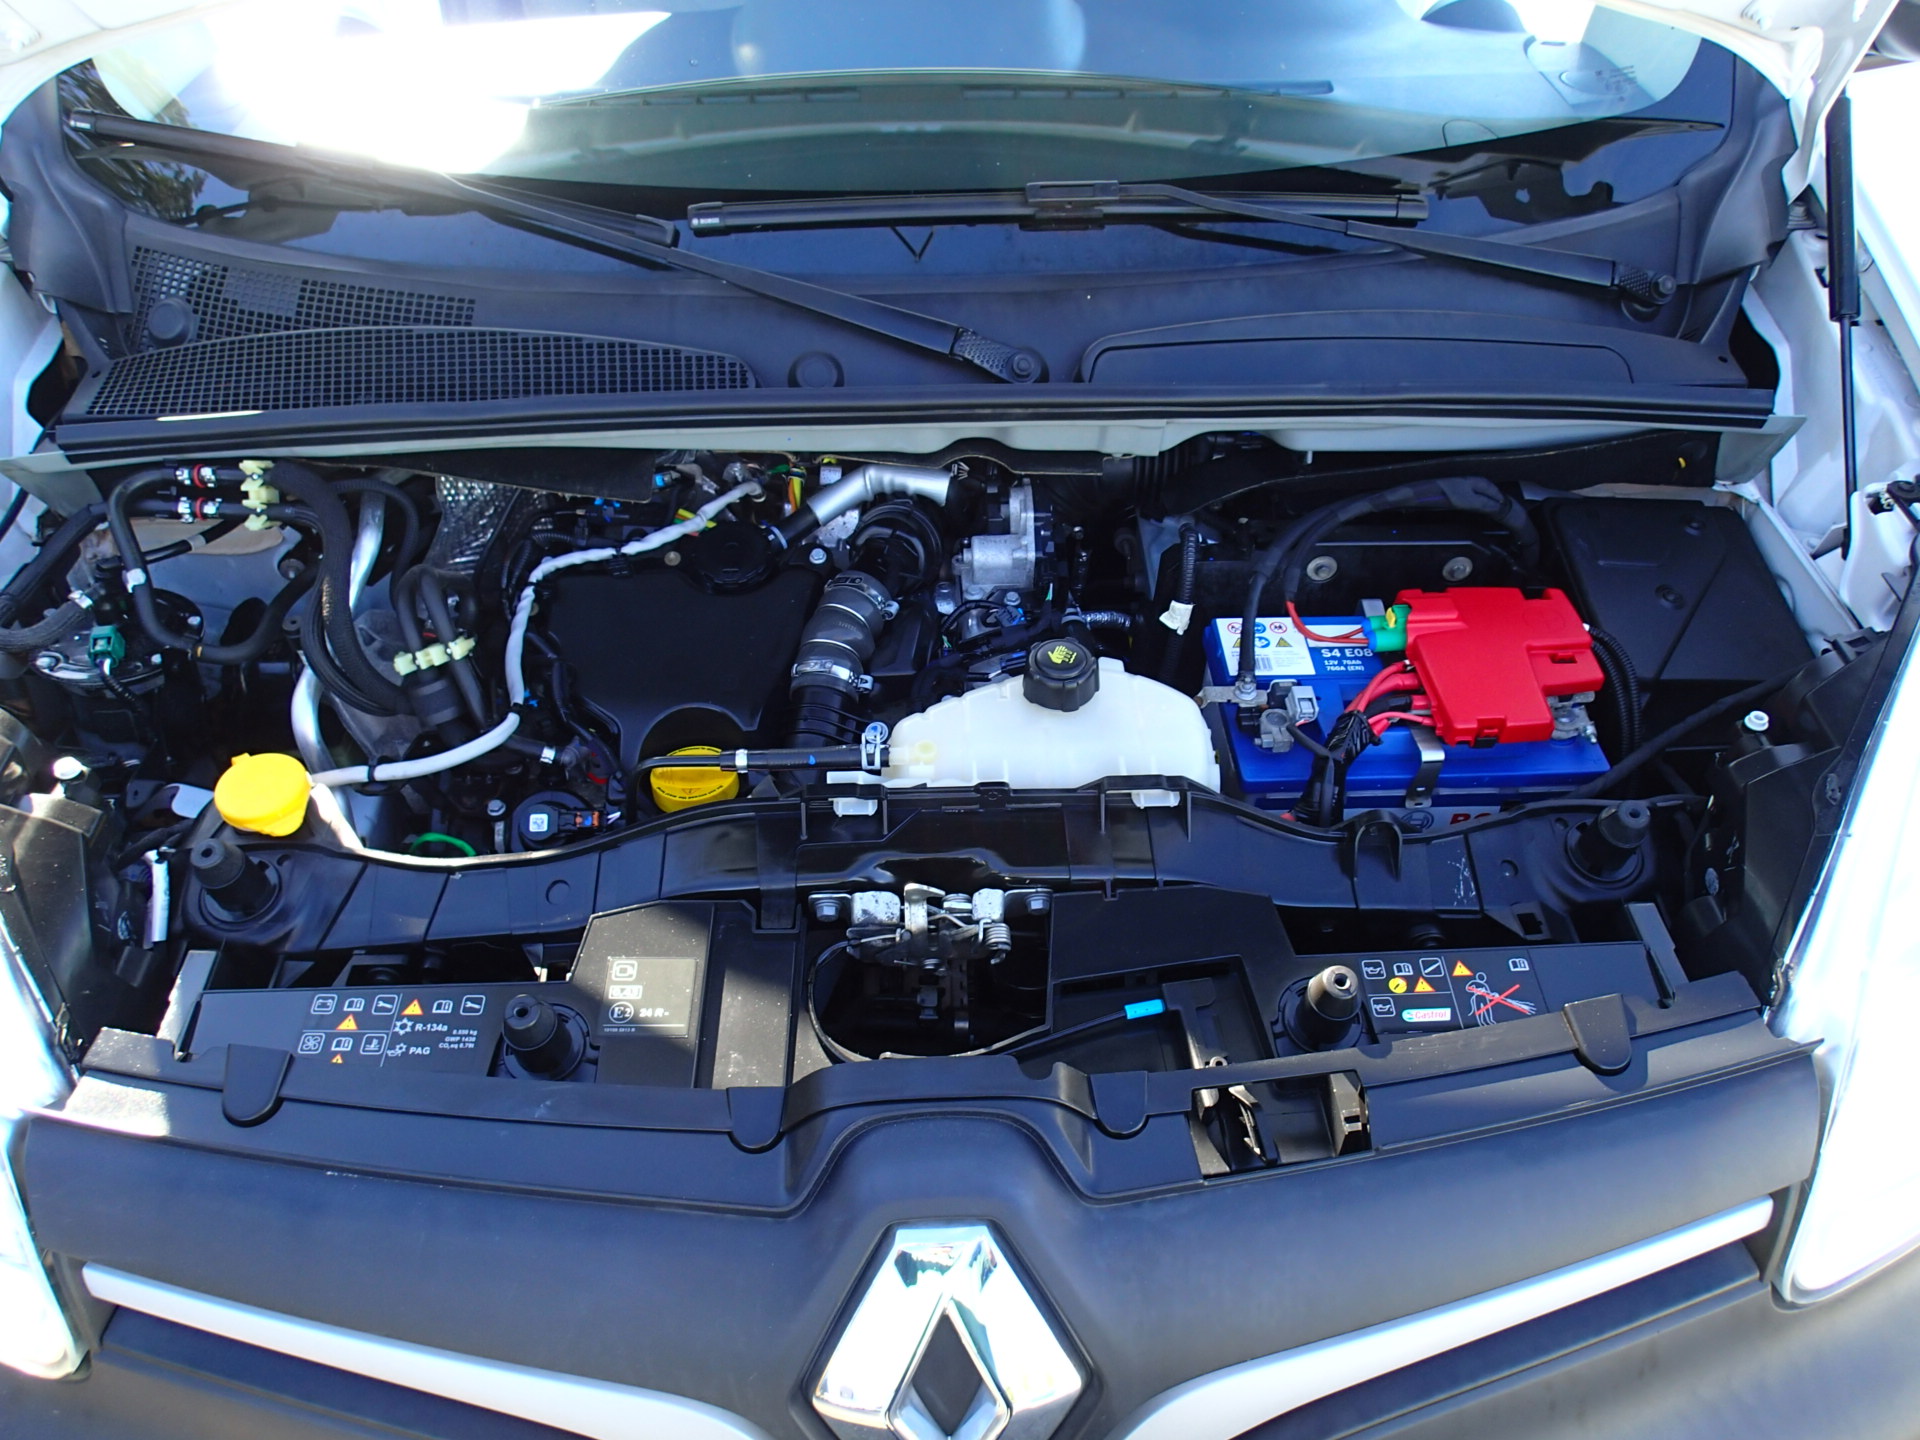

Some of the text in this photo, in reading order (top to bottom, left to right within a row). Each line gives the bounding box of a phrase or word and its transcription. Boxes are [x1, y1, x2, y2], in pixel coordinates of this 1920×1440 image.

[1321, 648, 1373, 658] S4 E08
[613, 1006, 631, 1018] E2
[1415, 1010, 1447, 1019] Castrol
[414, 1023, 448, 1032] R-134a
[409, 1046, 431, 1055] PAG
